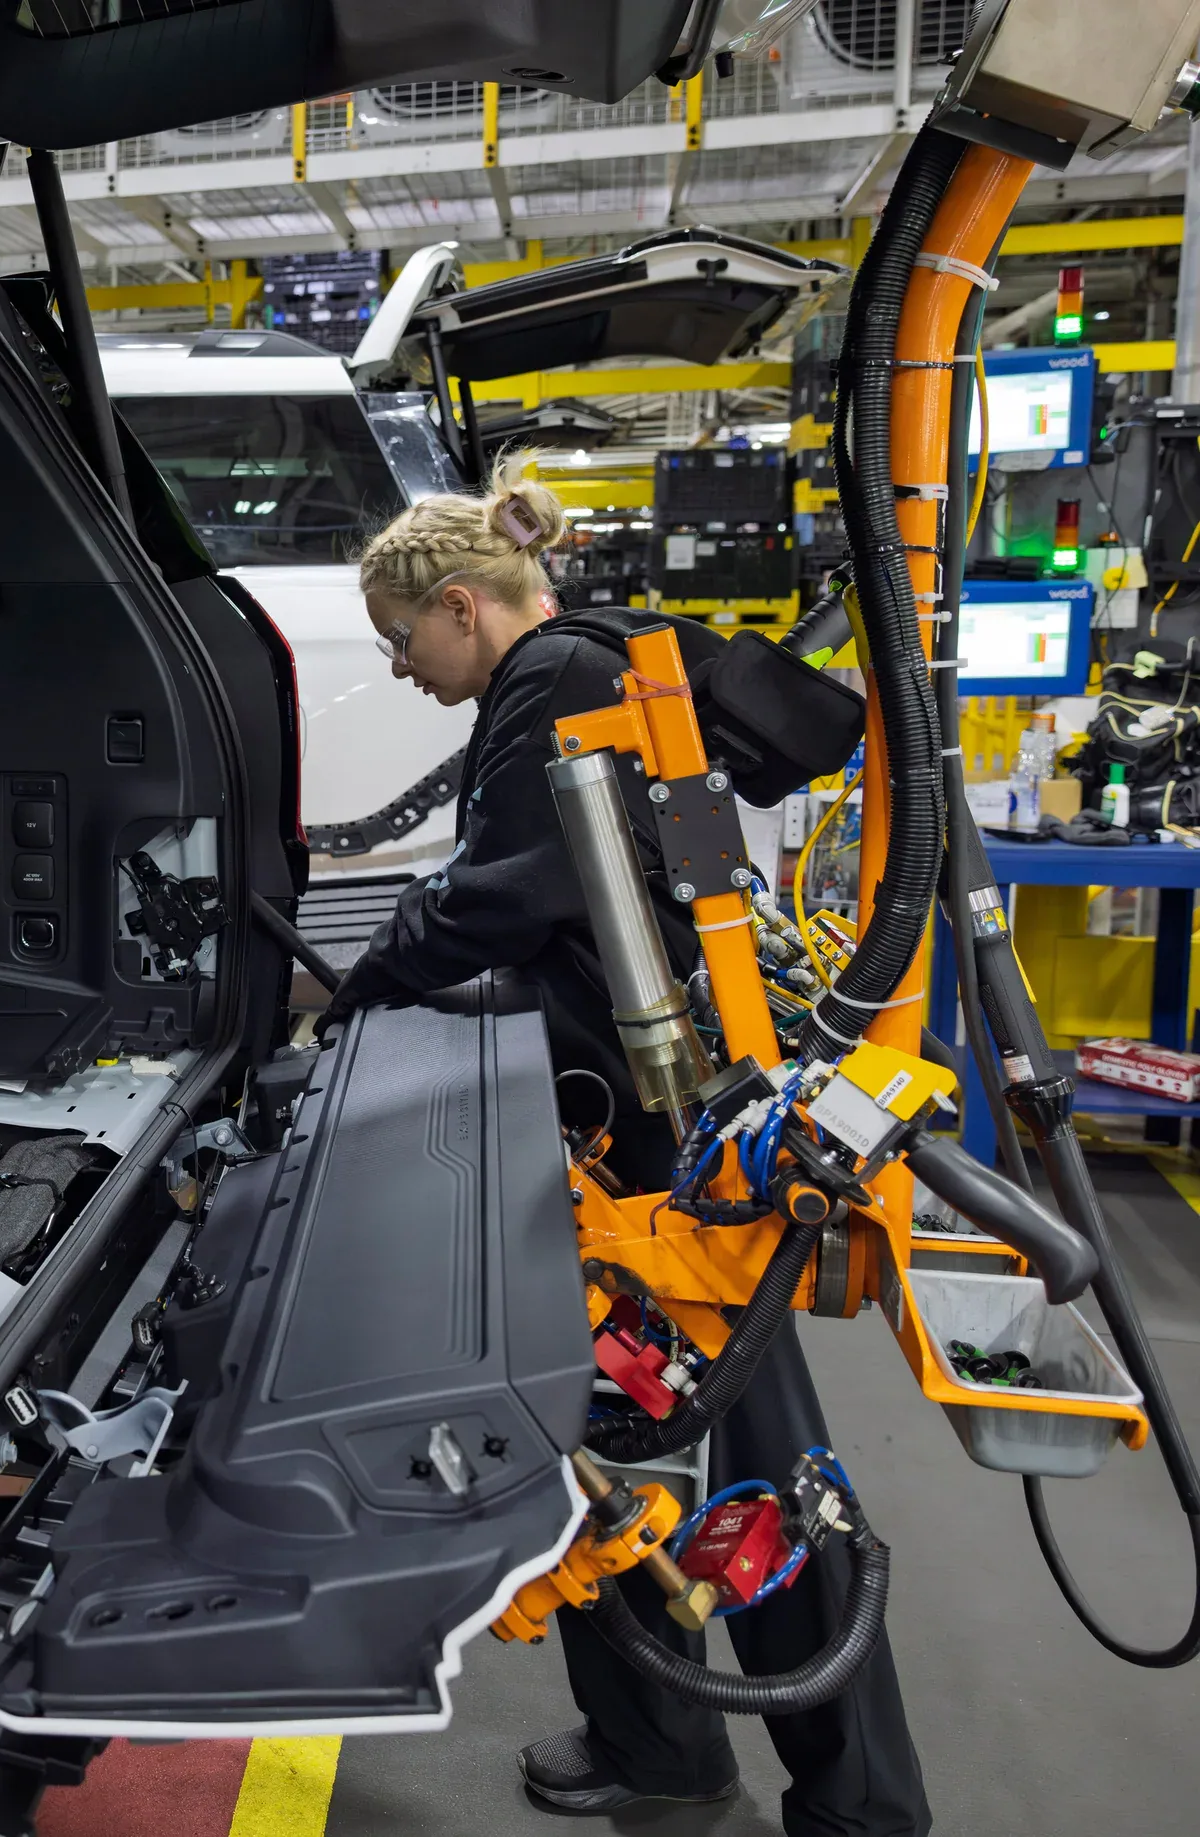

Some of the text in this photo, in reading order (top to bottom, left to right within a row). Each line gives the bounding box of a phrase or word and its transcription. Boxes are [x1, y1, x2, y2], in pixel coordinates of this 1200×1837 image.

[1048, 353, 1090, 369] wood
[1048, 586, 1089, 599] wood
[877, 1076, 906, 1106] BPA9140
[718, 1516, 744, 1527] 1041
